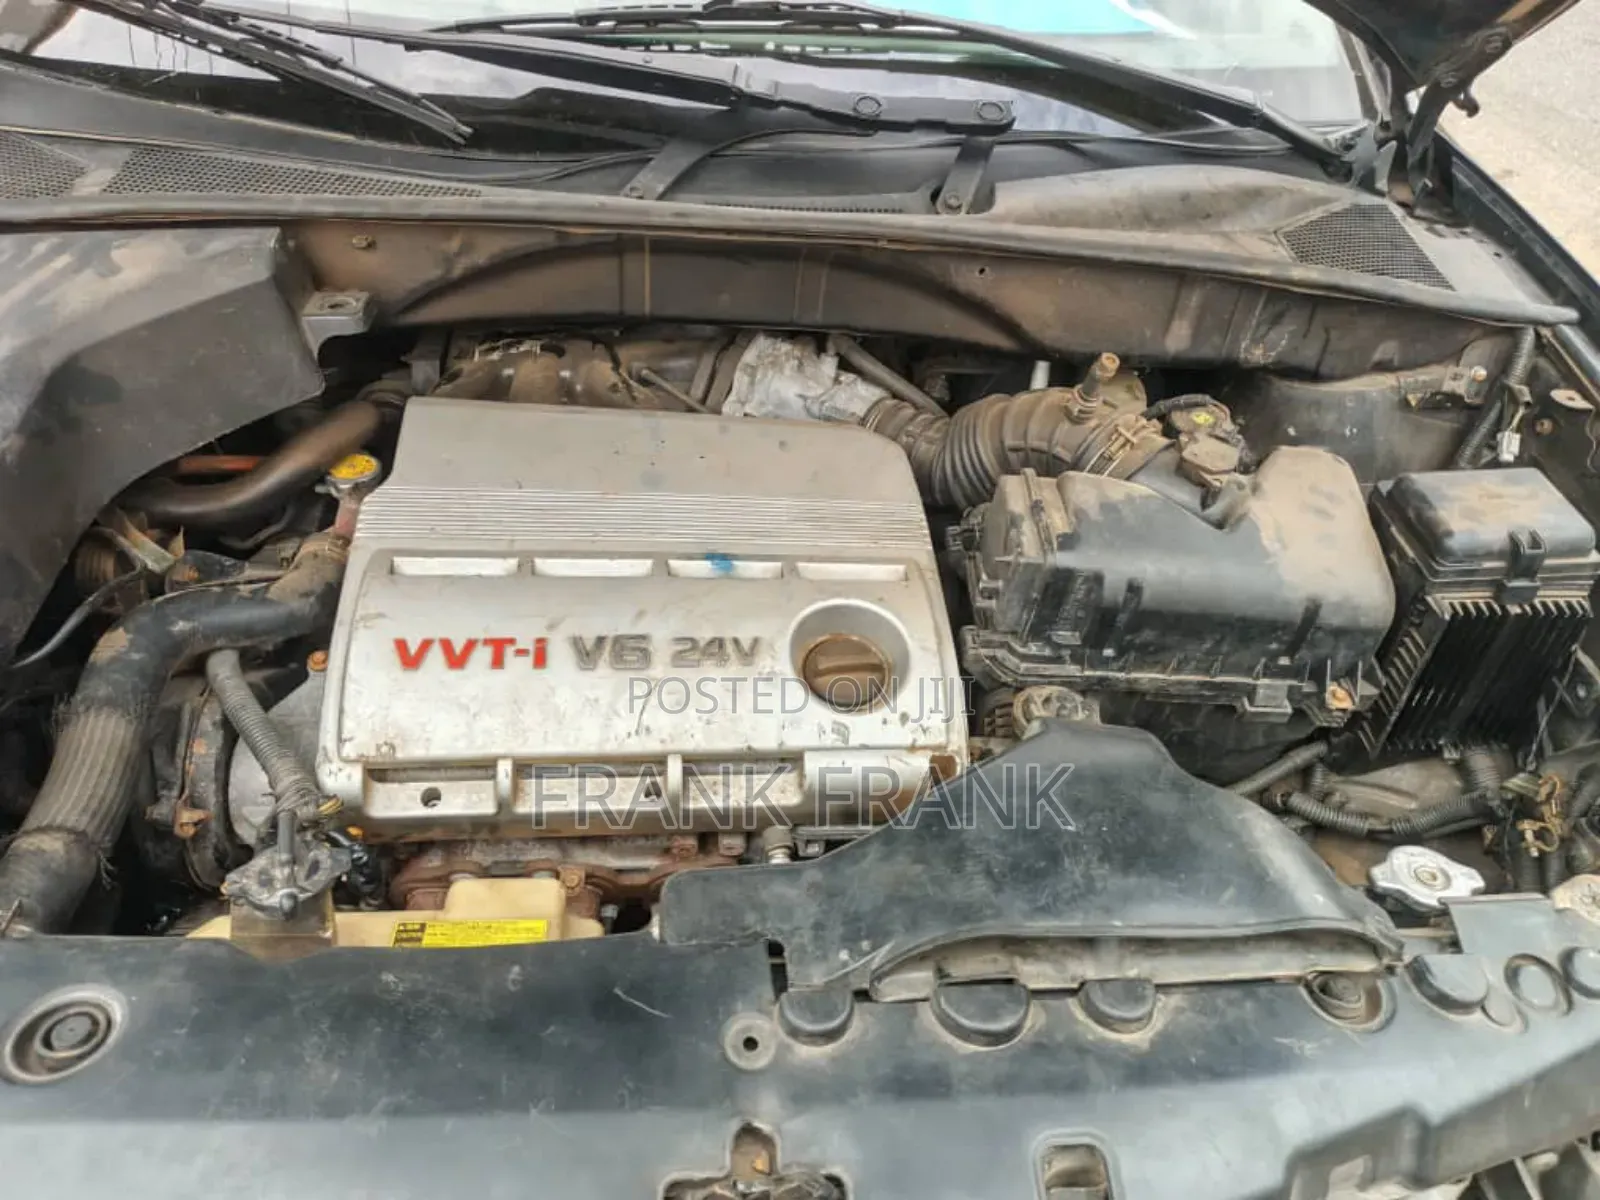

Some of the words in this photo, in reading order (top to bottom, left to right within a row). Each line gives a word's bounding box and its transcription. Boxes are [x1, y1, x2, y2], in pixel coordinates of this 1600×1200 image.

[393, 637, 548, 671] VVT-i
[572, 634, 651, 671] V6
[671, 636, 760, 668] 24V
